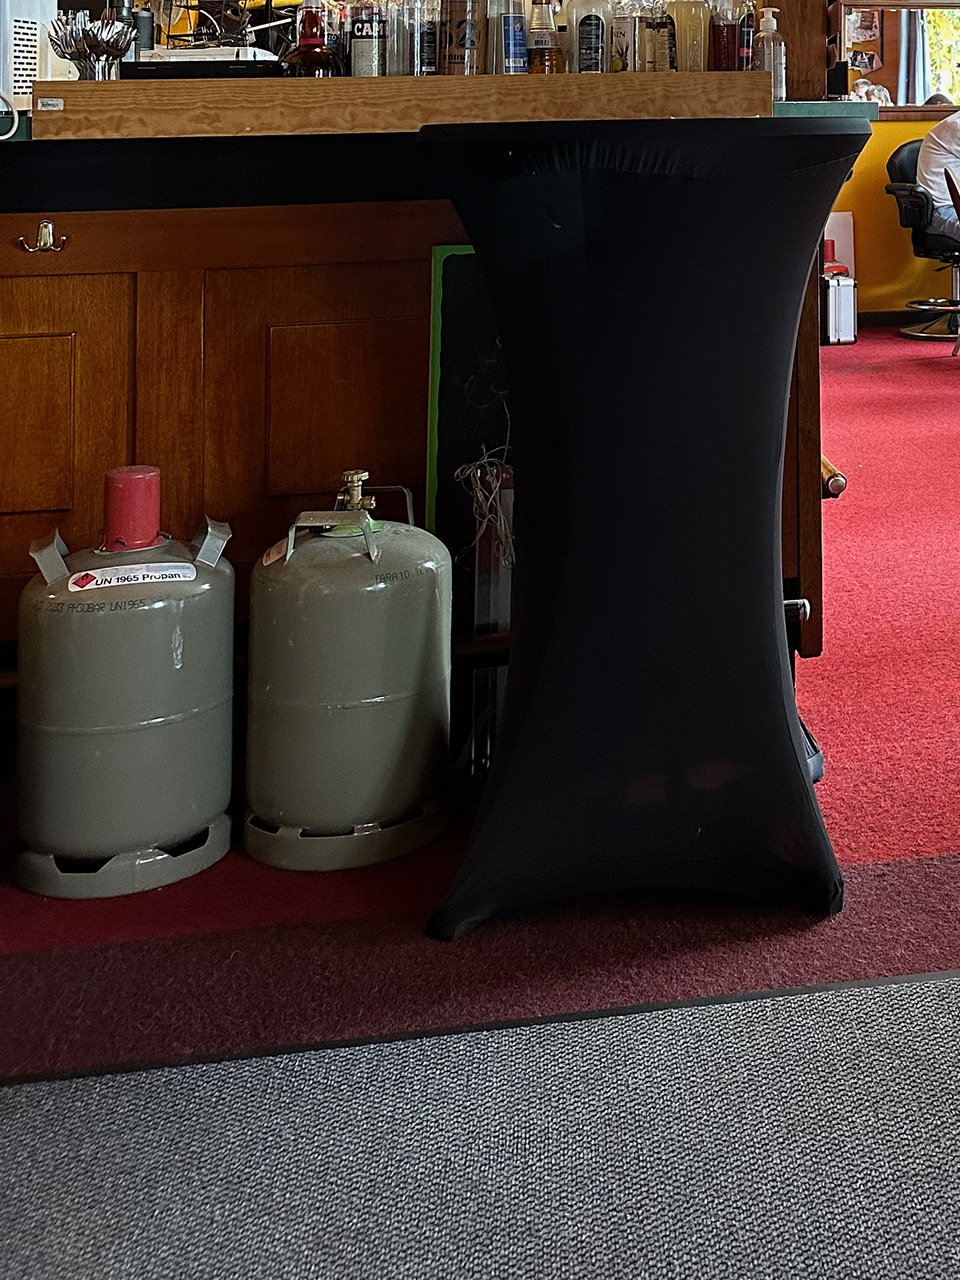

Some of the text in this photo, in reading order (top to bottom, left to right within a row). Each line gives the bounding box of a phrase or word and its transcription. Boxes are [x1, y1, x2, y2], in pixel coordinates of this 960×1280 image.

[95, 577, 112, 586] UN
[115, 574, 139, 584] 1965
[142, 572, 181, 581] Propan
